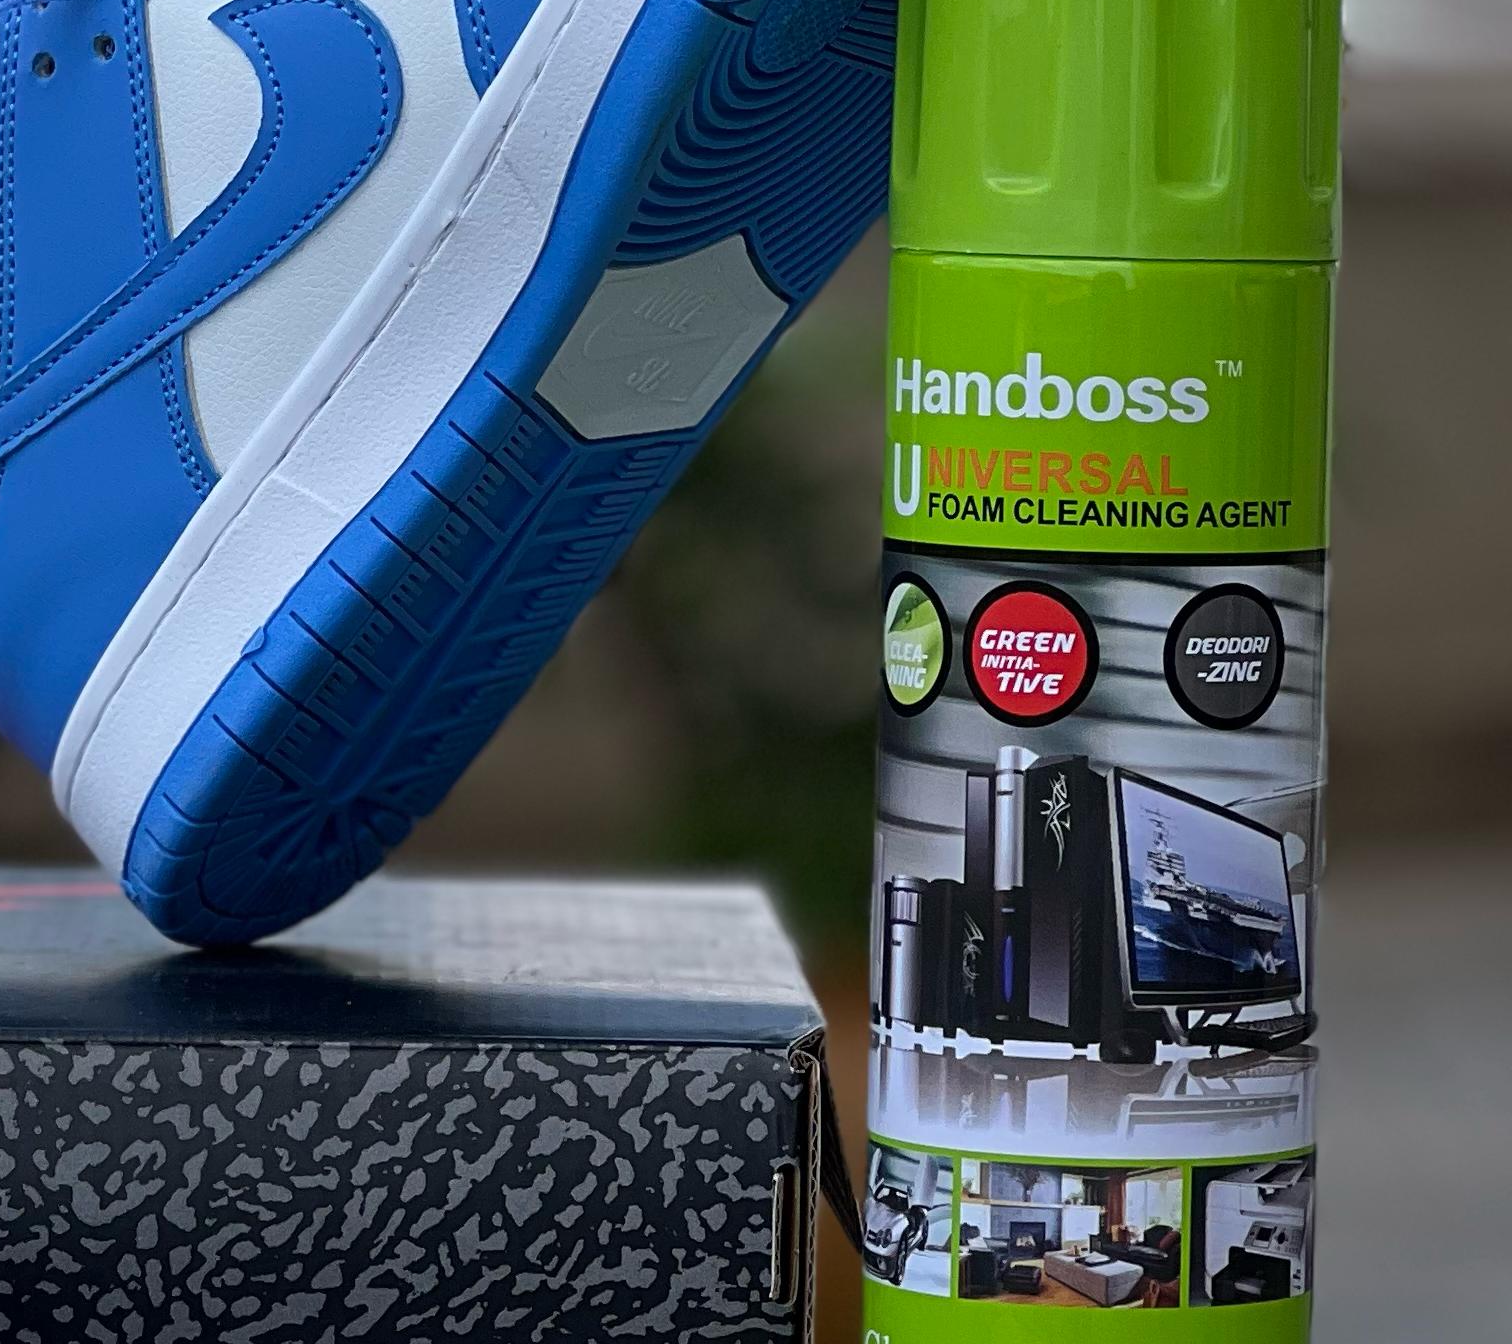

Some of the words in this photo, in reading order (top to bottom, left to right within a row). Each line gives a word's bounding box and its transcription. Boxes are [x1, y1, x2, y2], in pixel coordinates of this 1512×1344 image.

[895, 352, 1210, 423] Handboss
[928, 492, 1004, 523] FOAM
[1013, 497, 1189, 528] CLEANING
[1195, 500, 1291, 528] AGENT
[890, 641, 928, 662] CLEA-
[980, 629, 1076, 653] GREEN
[1186, 636, 1269, 656] DEODORI
[981, 654, 1040, 670] INITIA-
[1197, 661, 1262, 683] -ZING
[888, 664, 926, 689] NING
[997, 671, 1063, 696] TIVE
